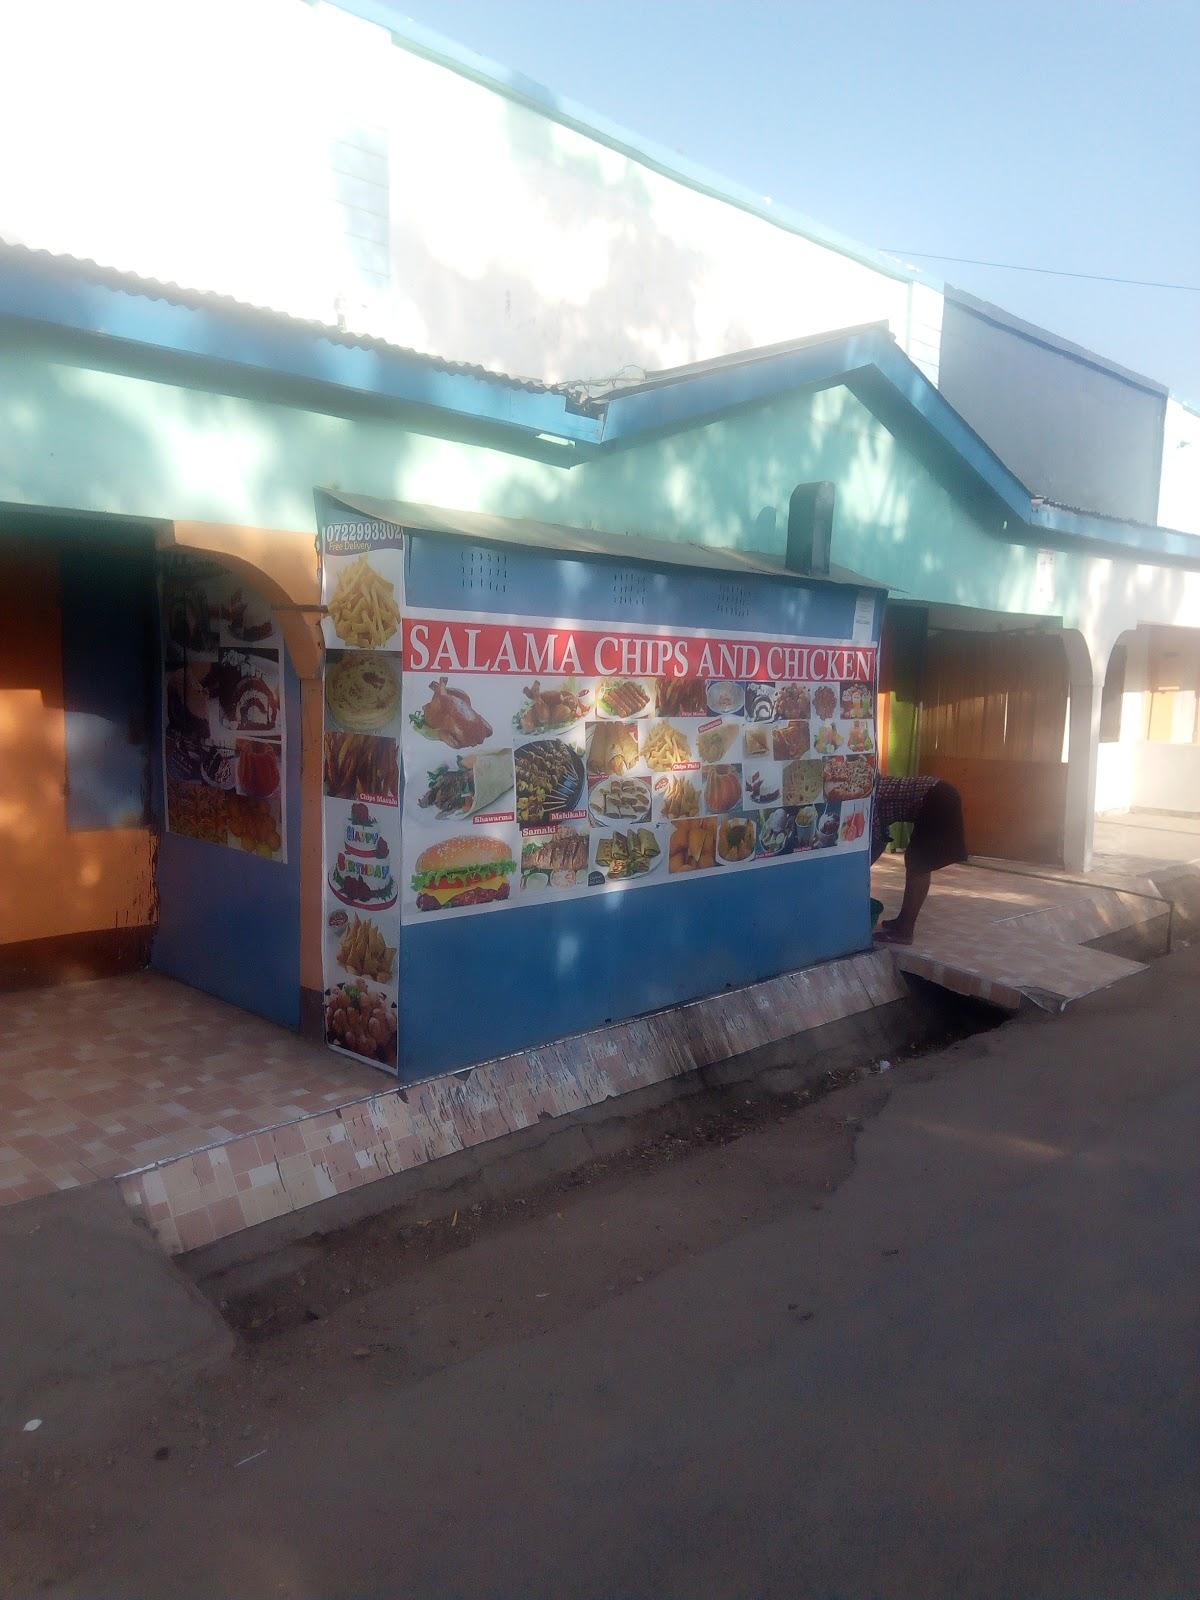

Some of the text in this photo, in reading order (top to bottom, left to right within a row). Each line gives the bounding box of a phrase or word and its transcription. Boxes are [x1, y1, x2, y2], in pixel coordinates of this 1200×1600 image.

[326, 522, 402, 542] 0722993302
[329, 540, 371, 551] Free Delivery
[410, 624, 872, 682] SALAMA CHIPS AND CHICKEN
[359, 792, 376, 803] Chips
[346, 825, 379, 845] HAPPY
[522, 825, 556, 836] Samaki
[337, 853, 390, 880] BIRTHDAY
